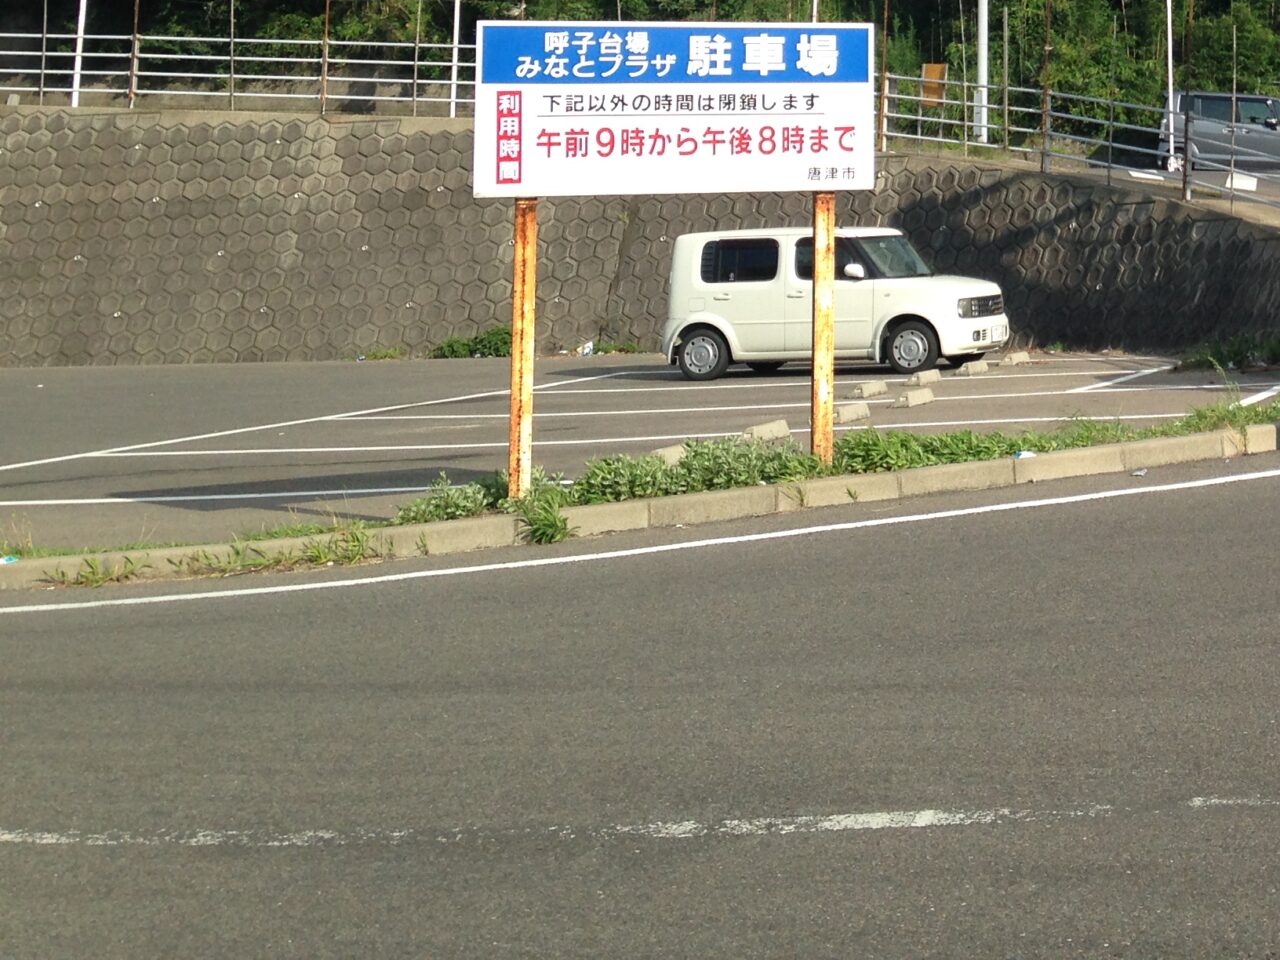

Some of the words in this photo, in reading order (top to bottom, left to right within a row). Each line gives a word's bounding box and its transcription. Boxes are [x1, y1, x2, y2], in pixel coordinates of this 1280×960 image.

[544, 31, 650, 55] 呼子台場
[686, 33, 839, 76] 駐車場
[515, 54, 677, 78] みなとプラザ
[542, 93, 820, 113] 下記以外の時間は閉鎖します
[499, 94, 520, 180] 利用時間
[536, 126, 856, 158] 午前9時から午後8時まで
[807, 167, 856, 181] 唐津市
